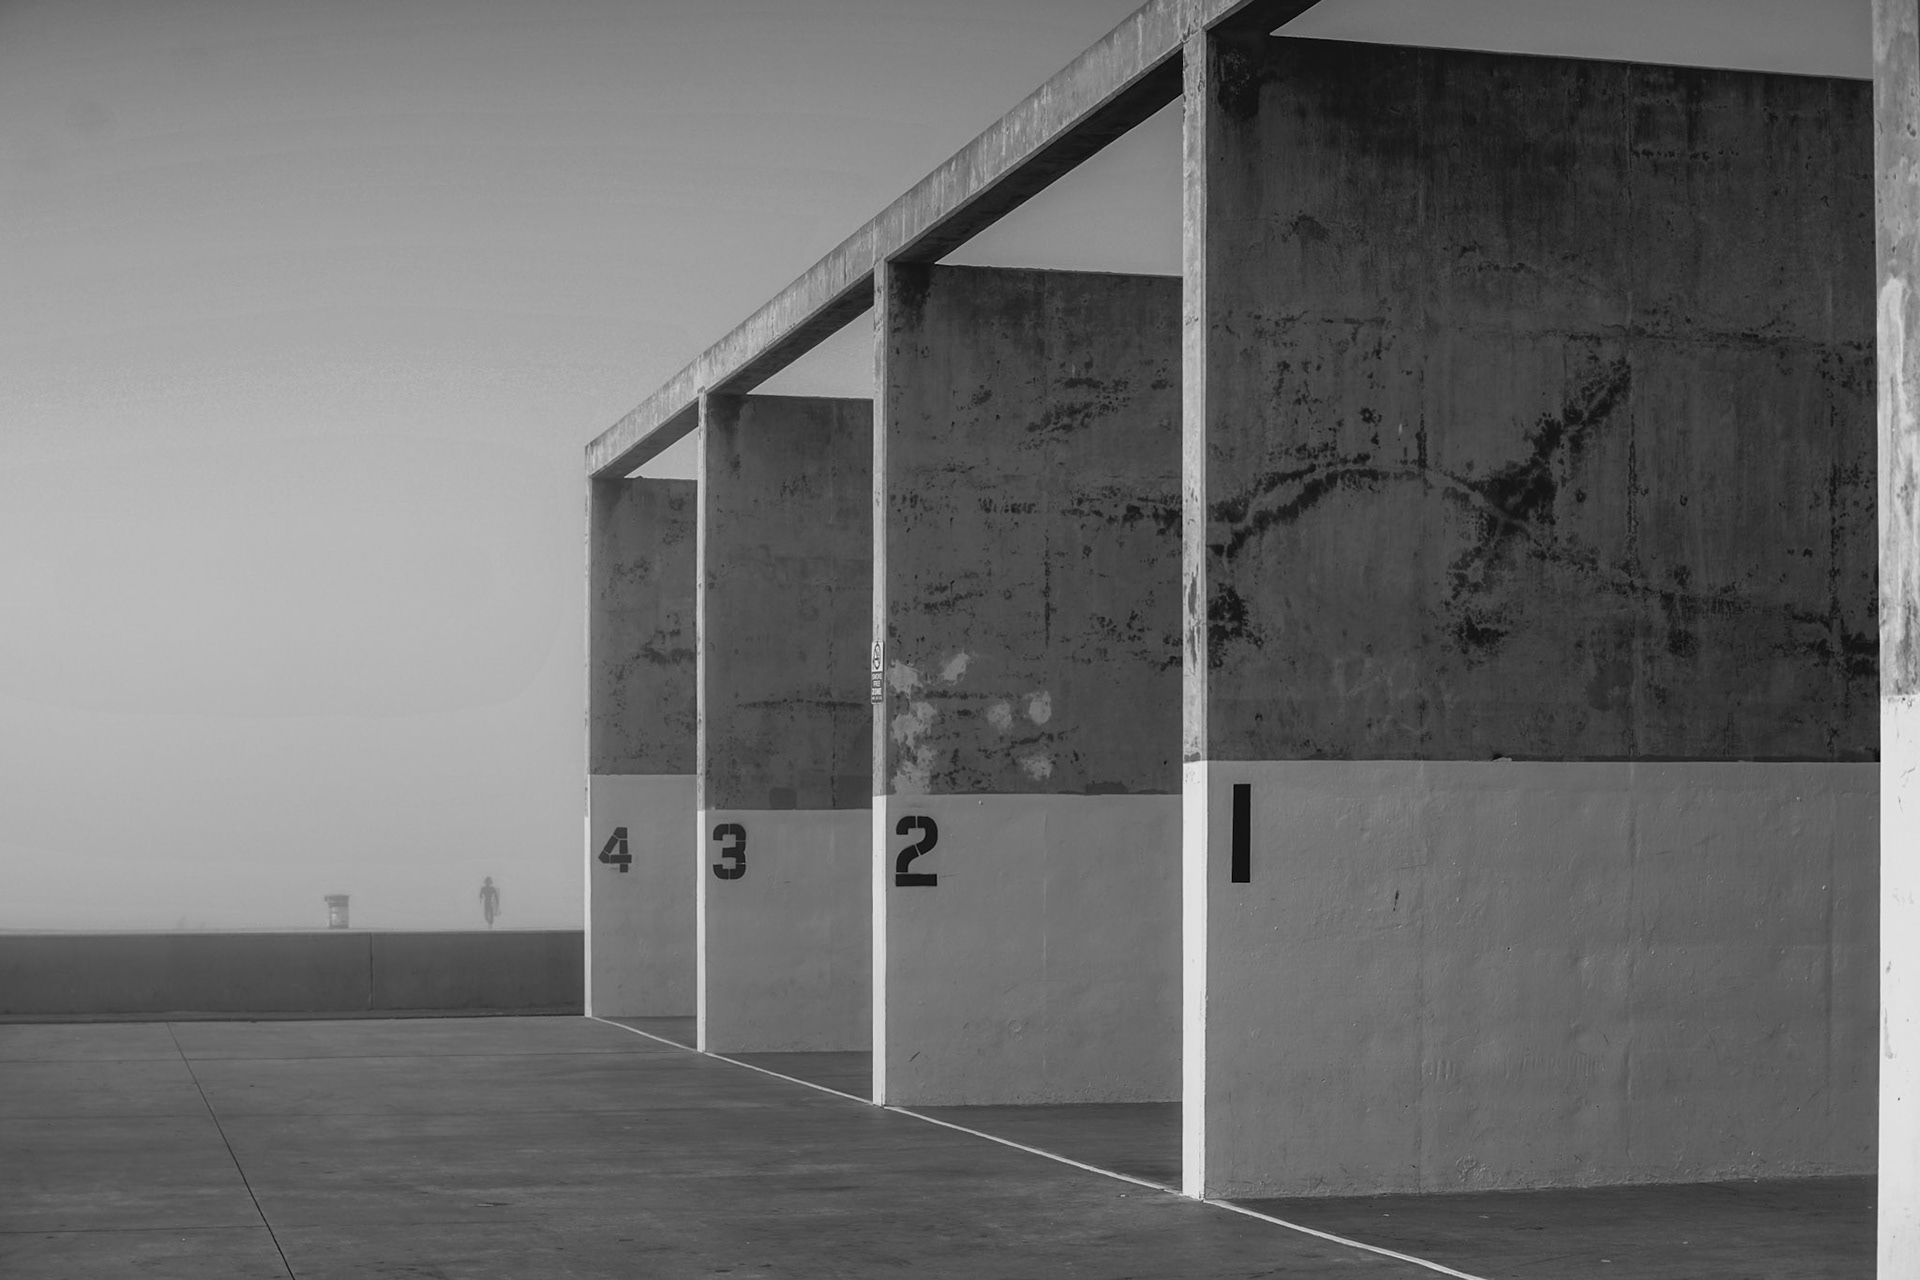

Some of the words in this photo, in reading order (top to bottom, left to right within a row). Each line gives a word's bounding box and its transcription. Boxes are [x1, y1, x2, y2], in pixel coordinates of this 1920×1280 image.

[599, 827, 632, 873] 4
[713, 824, 747, 880] 3
[896, 816, 939, 886] 2
